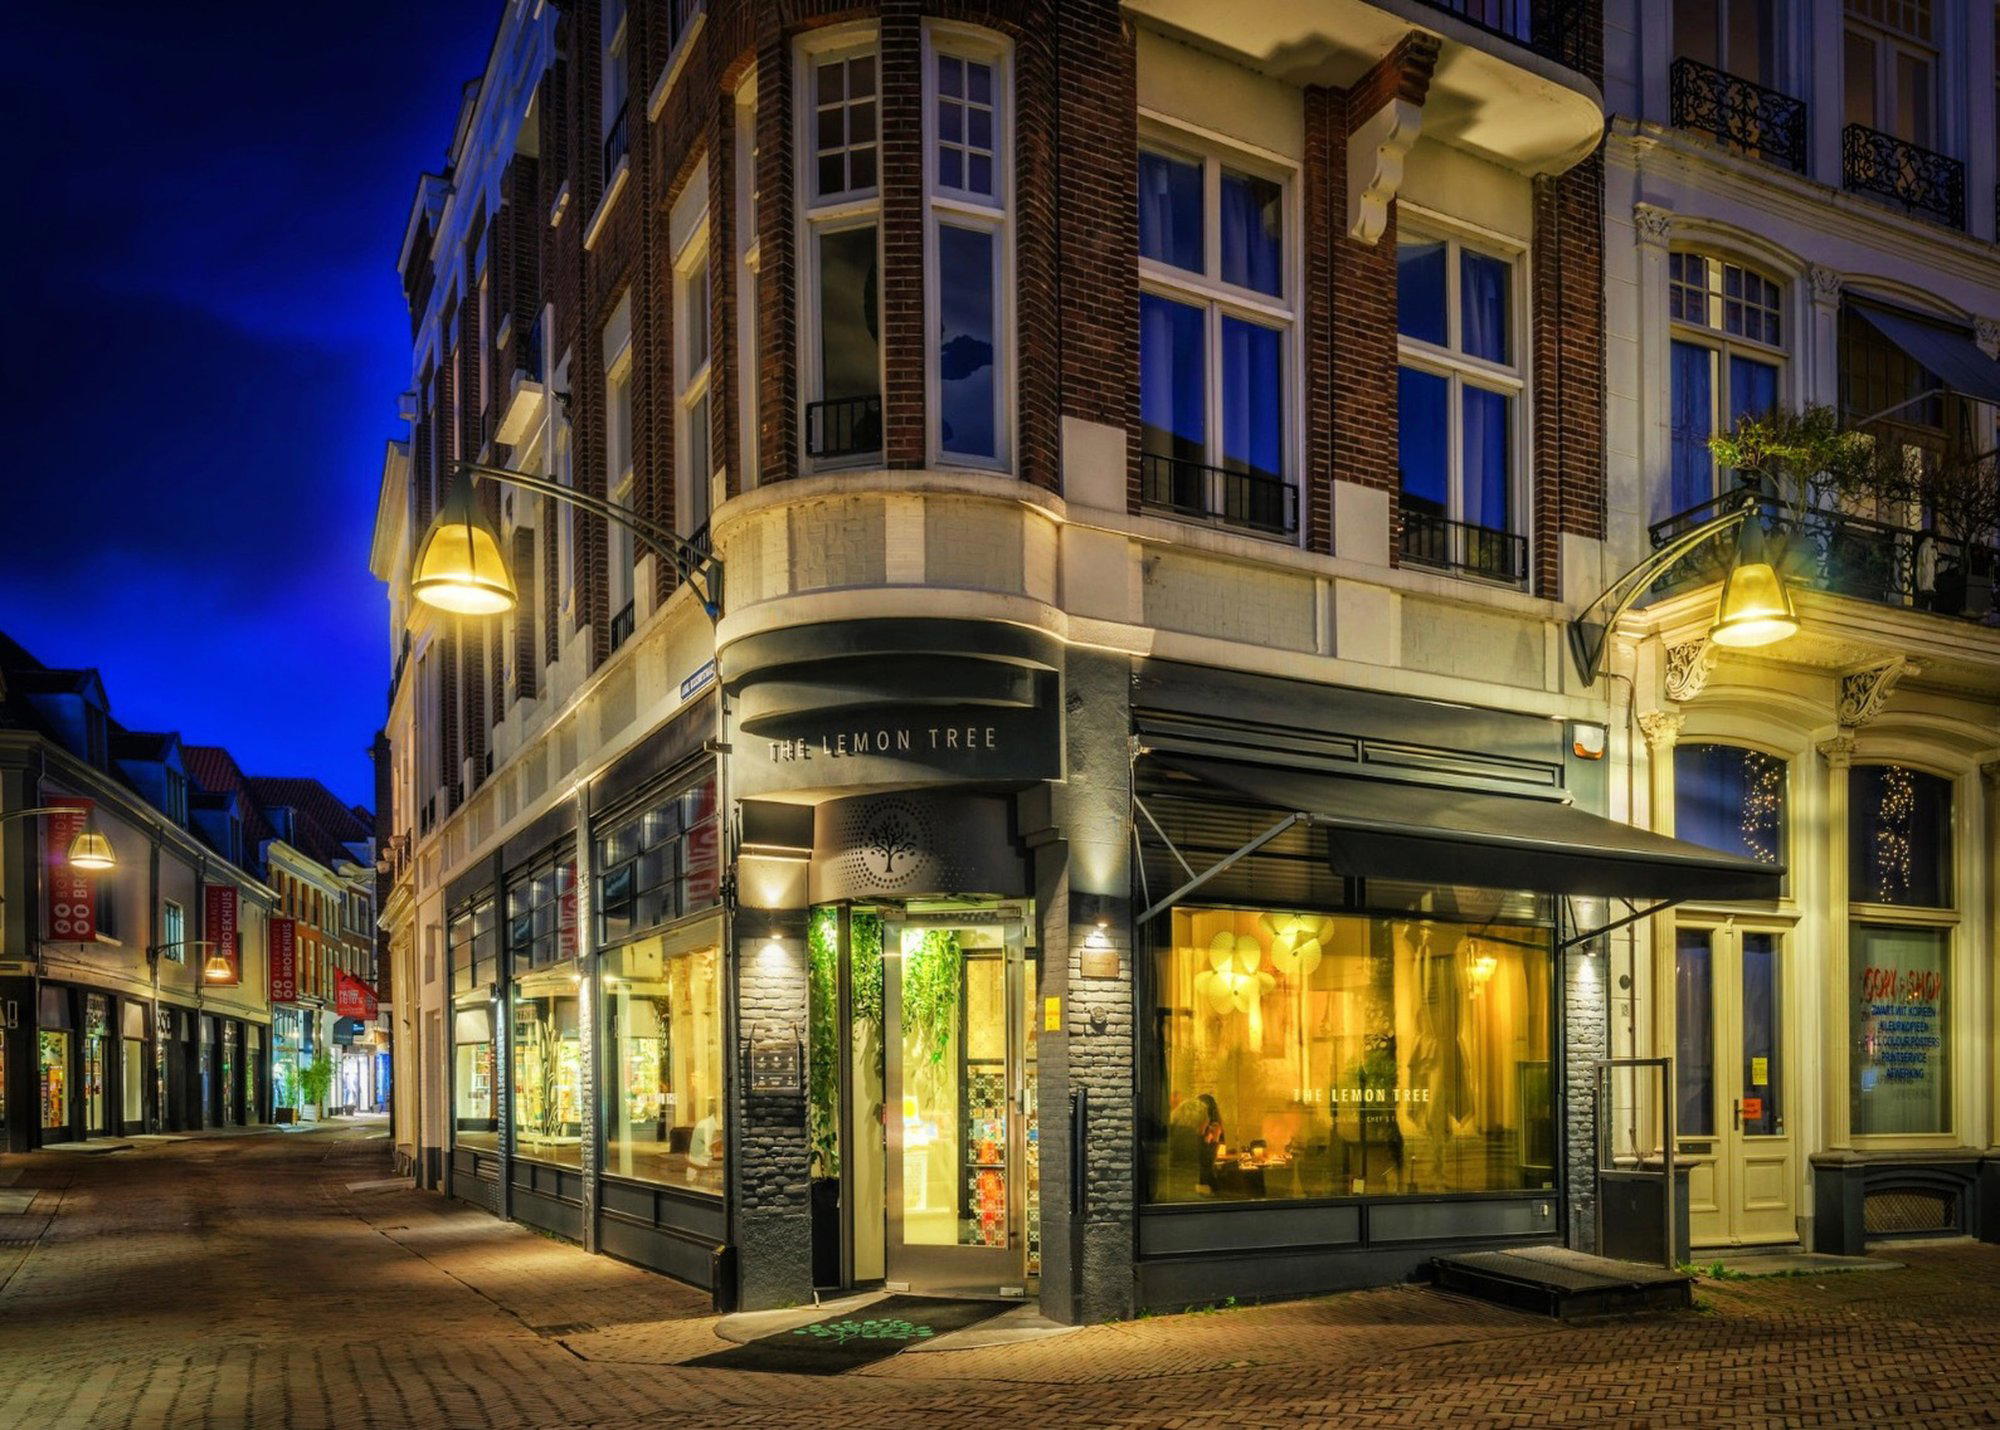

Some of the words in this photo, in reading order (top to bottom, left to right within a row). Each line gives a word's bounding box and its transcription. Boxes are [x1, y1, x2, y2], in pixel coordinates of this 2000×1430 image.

[768, 737, 806, 760] THE
[822, 729, 911, 755] LEMON
[929, 727, 997, 750] TREE
[222, 891, 233, 956] BROEKHUIS
[282, 922, 292, 977] BROEKHUIS
[1293, 1088, 1322, 1103] THE
[1331, 1088, 1385, 1103] LEMON
[1392, 1088, 1430, 1103] TREE
